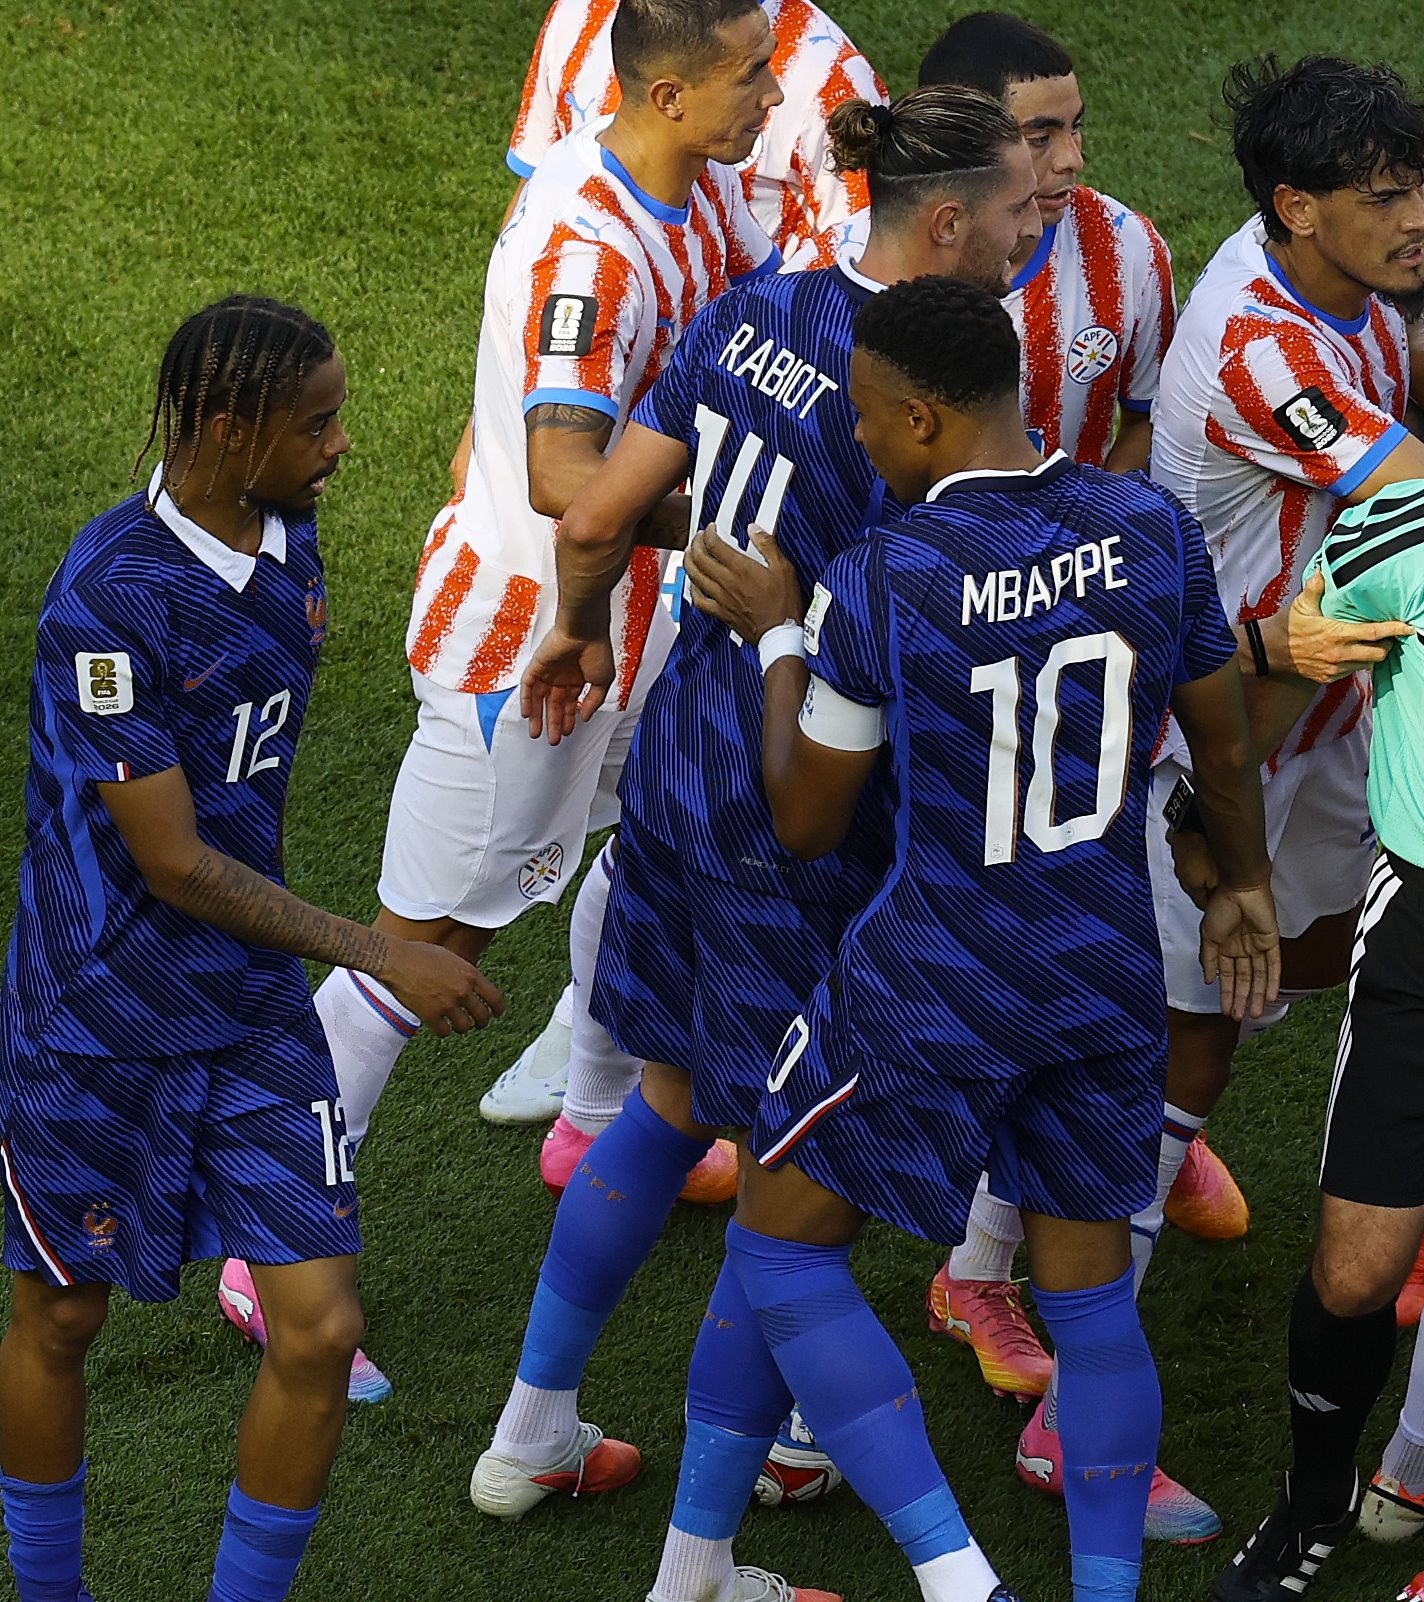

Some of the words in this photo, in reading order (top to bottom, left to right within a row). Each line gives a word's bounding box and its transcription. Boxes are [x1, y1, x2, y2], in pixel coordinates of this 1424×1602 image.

[717, 322, 838, 420] RABIOT
[1083, 330, 1102, 342] APF
[961, 534, 1128, 626] MBAPPE
[225, 688, 292, 784] 12
[969, 630, 1137, 867] 10
[311, 1097, 355, 1186] 12
